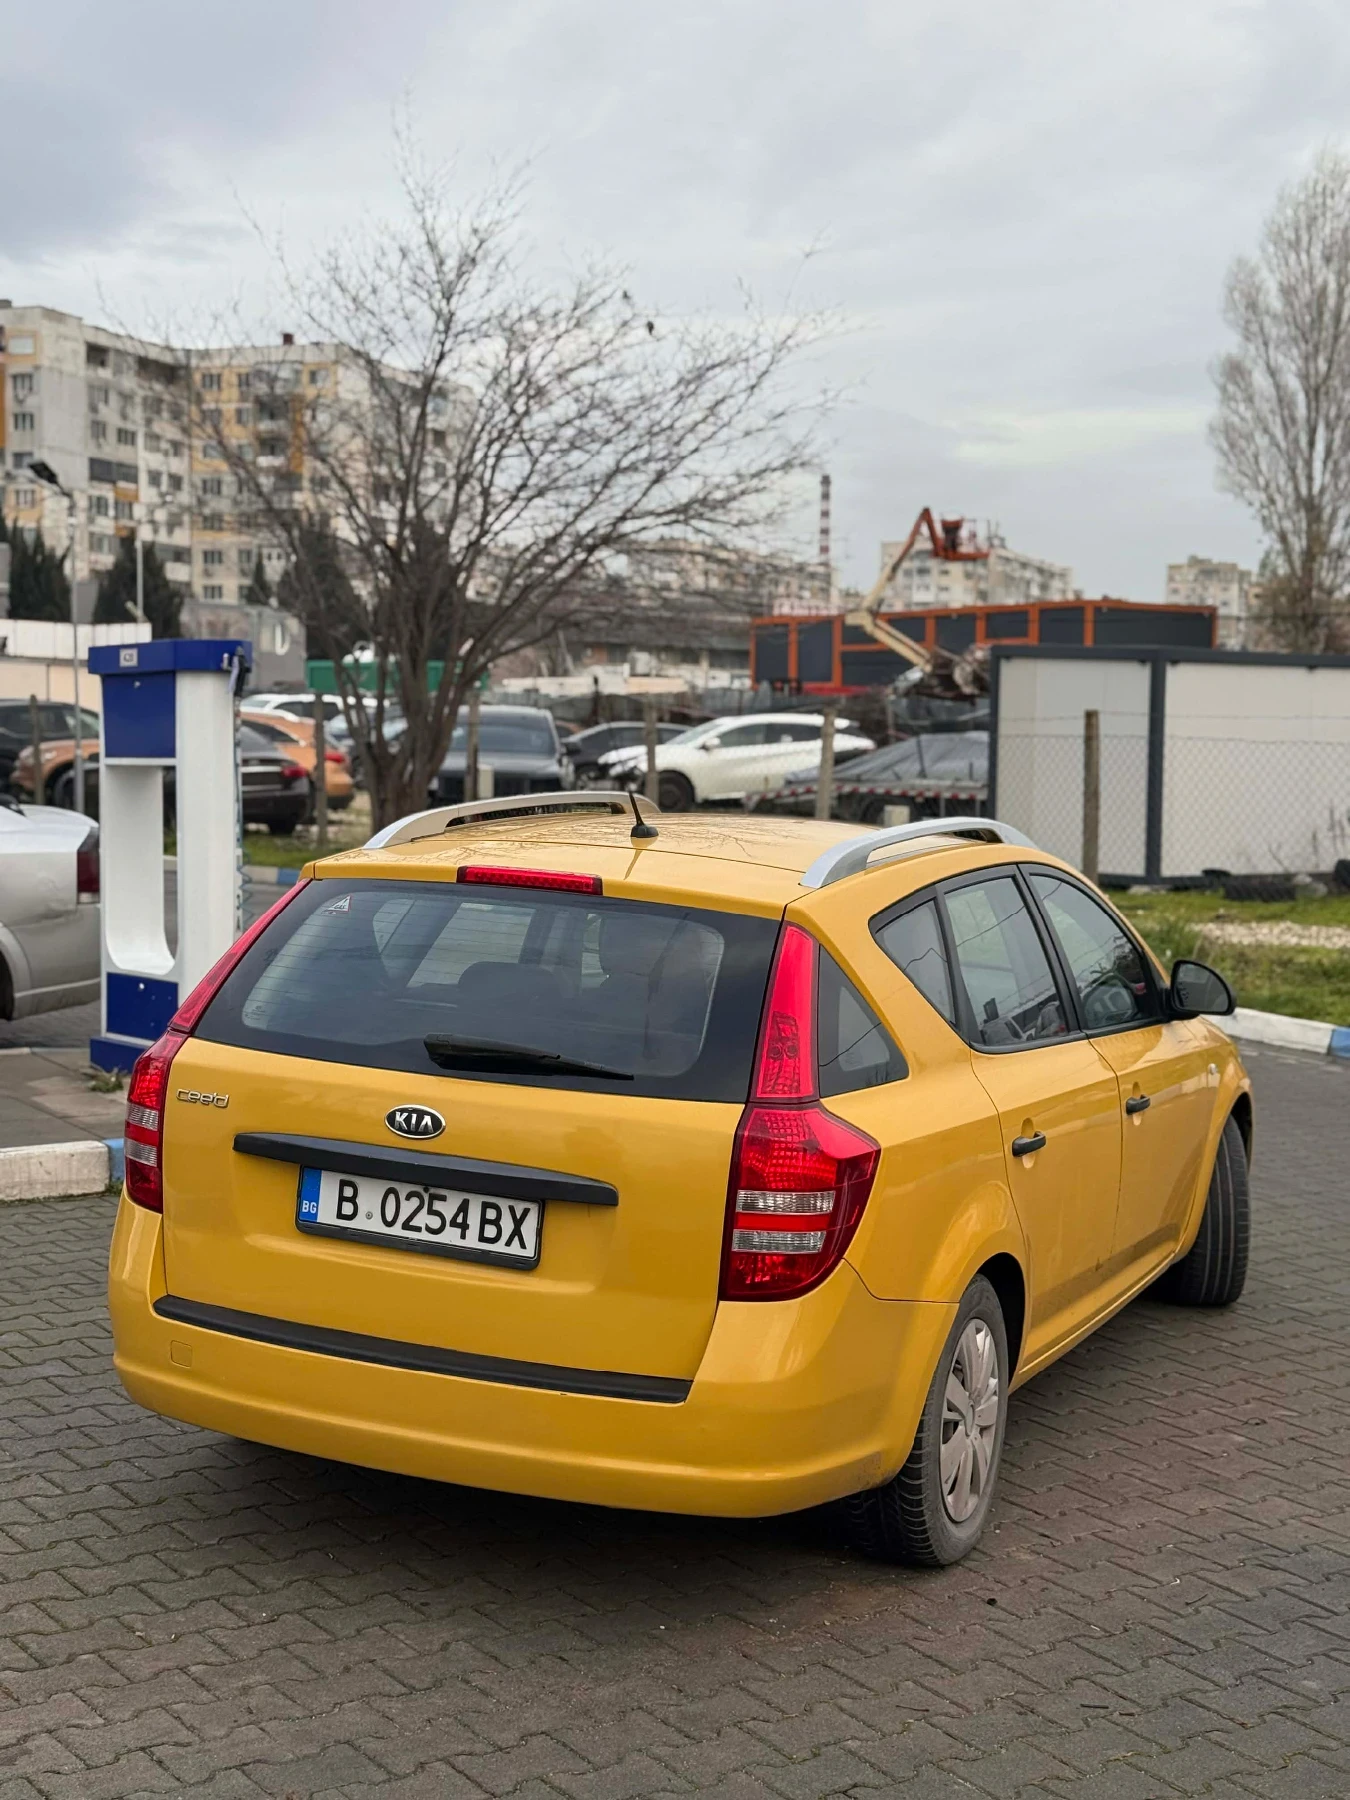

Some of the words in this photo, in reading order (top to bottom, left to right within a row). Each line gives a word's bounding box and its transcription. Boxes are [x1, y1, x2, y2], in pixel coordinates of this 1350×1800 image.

[394, 1111, 434, 1133] KIA
[302, 1200, 317, 1214] BG
[336, 1178, 359, 1221] B
